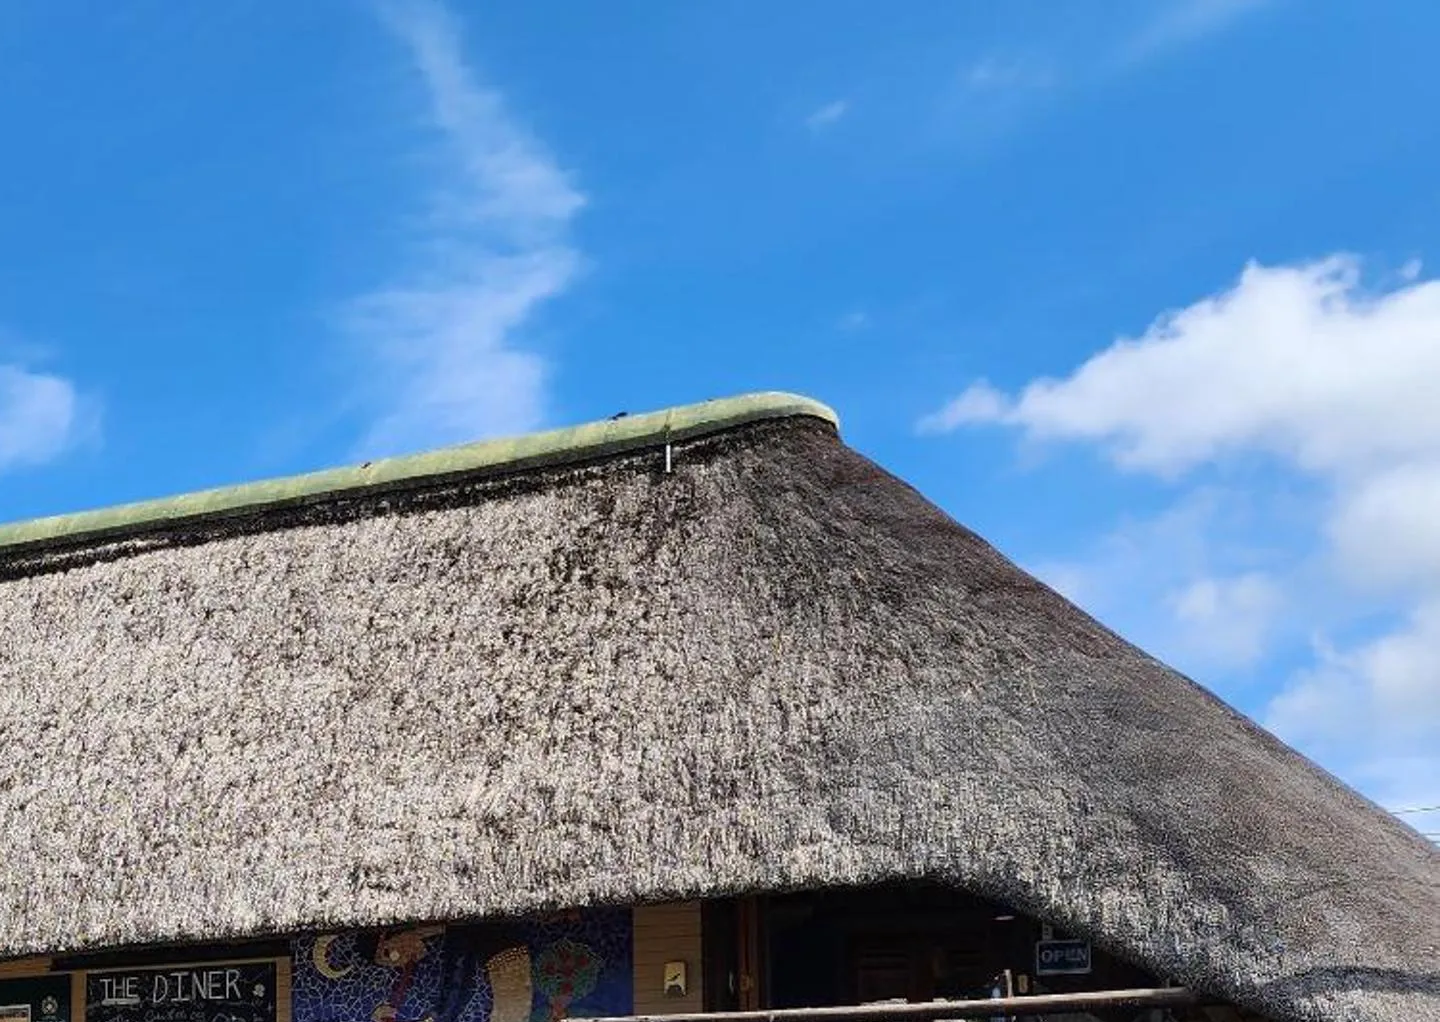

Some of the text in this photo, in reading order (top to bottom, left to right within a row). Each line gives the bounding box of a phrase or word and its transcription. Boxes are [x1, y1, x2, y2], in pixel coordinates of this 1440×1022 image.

[1041, 948, 1088, 963] OPEN
[99, 969, 242, 1003] THE DINER
